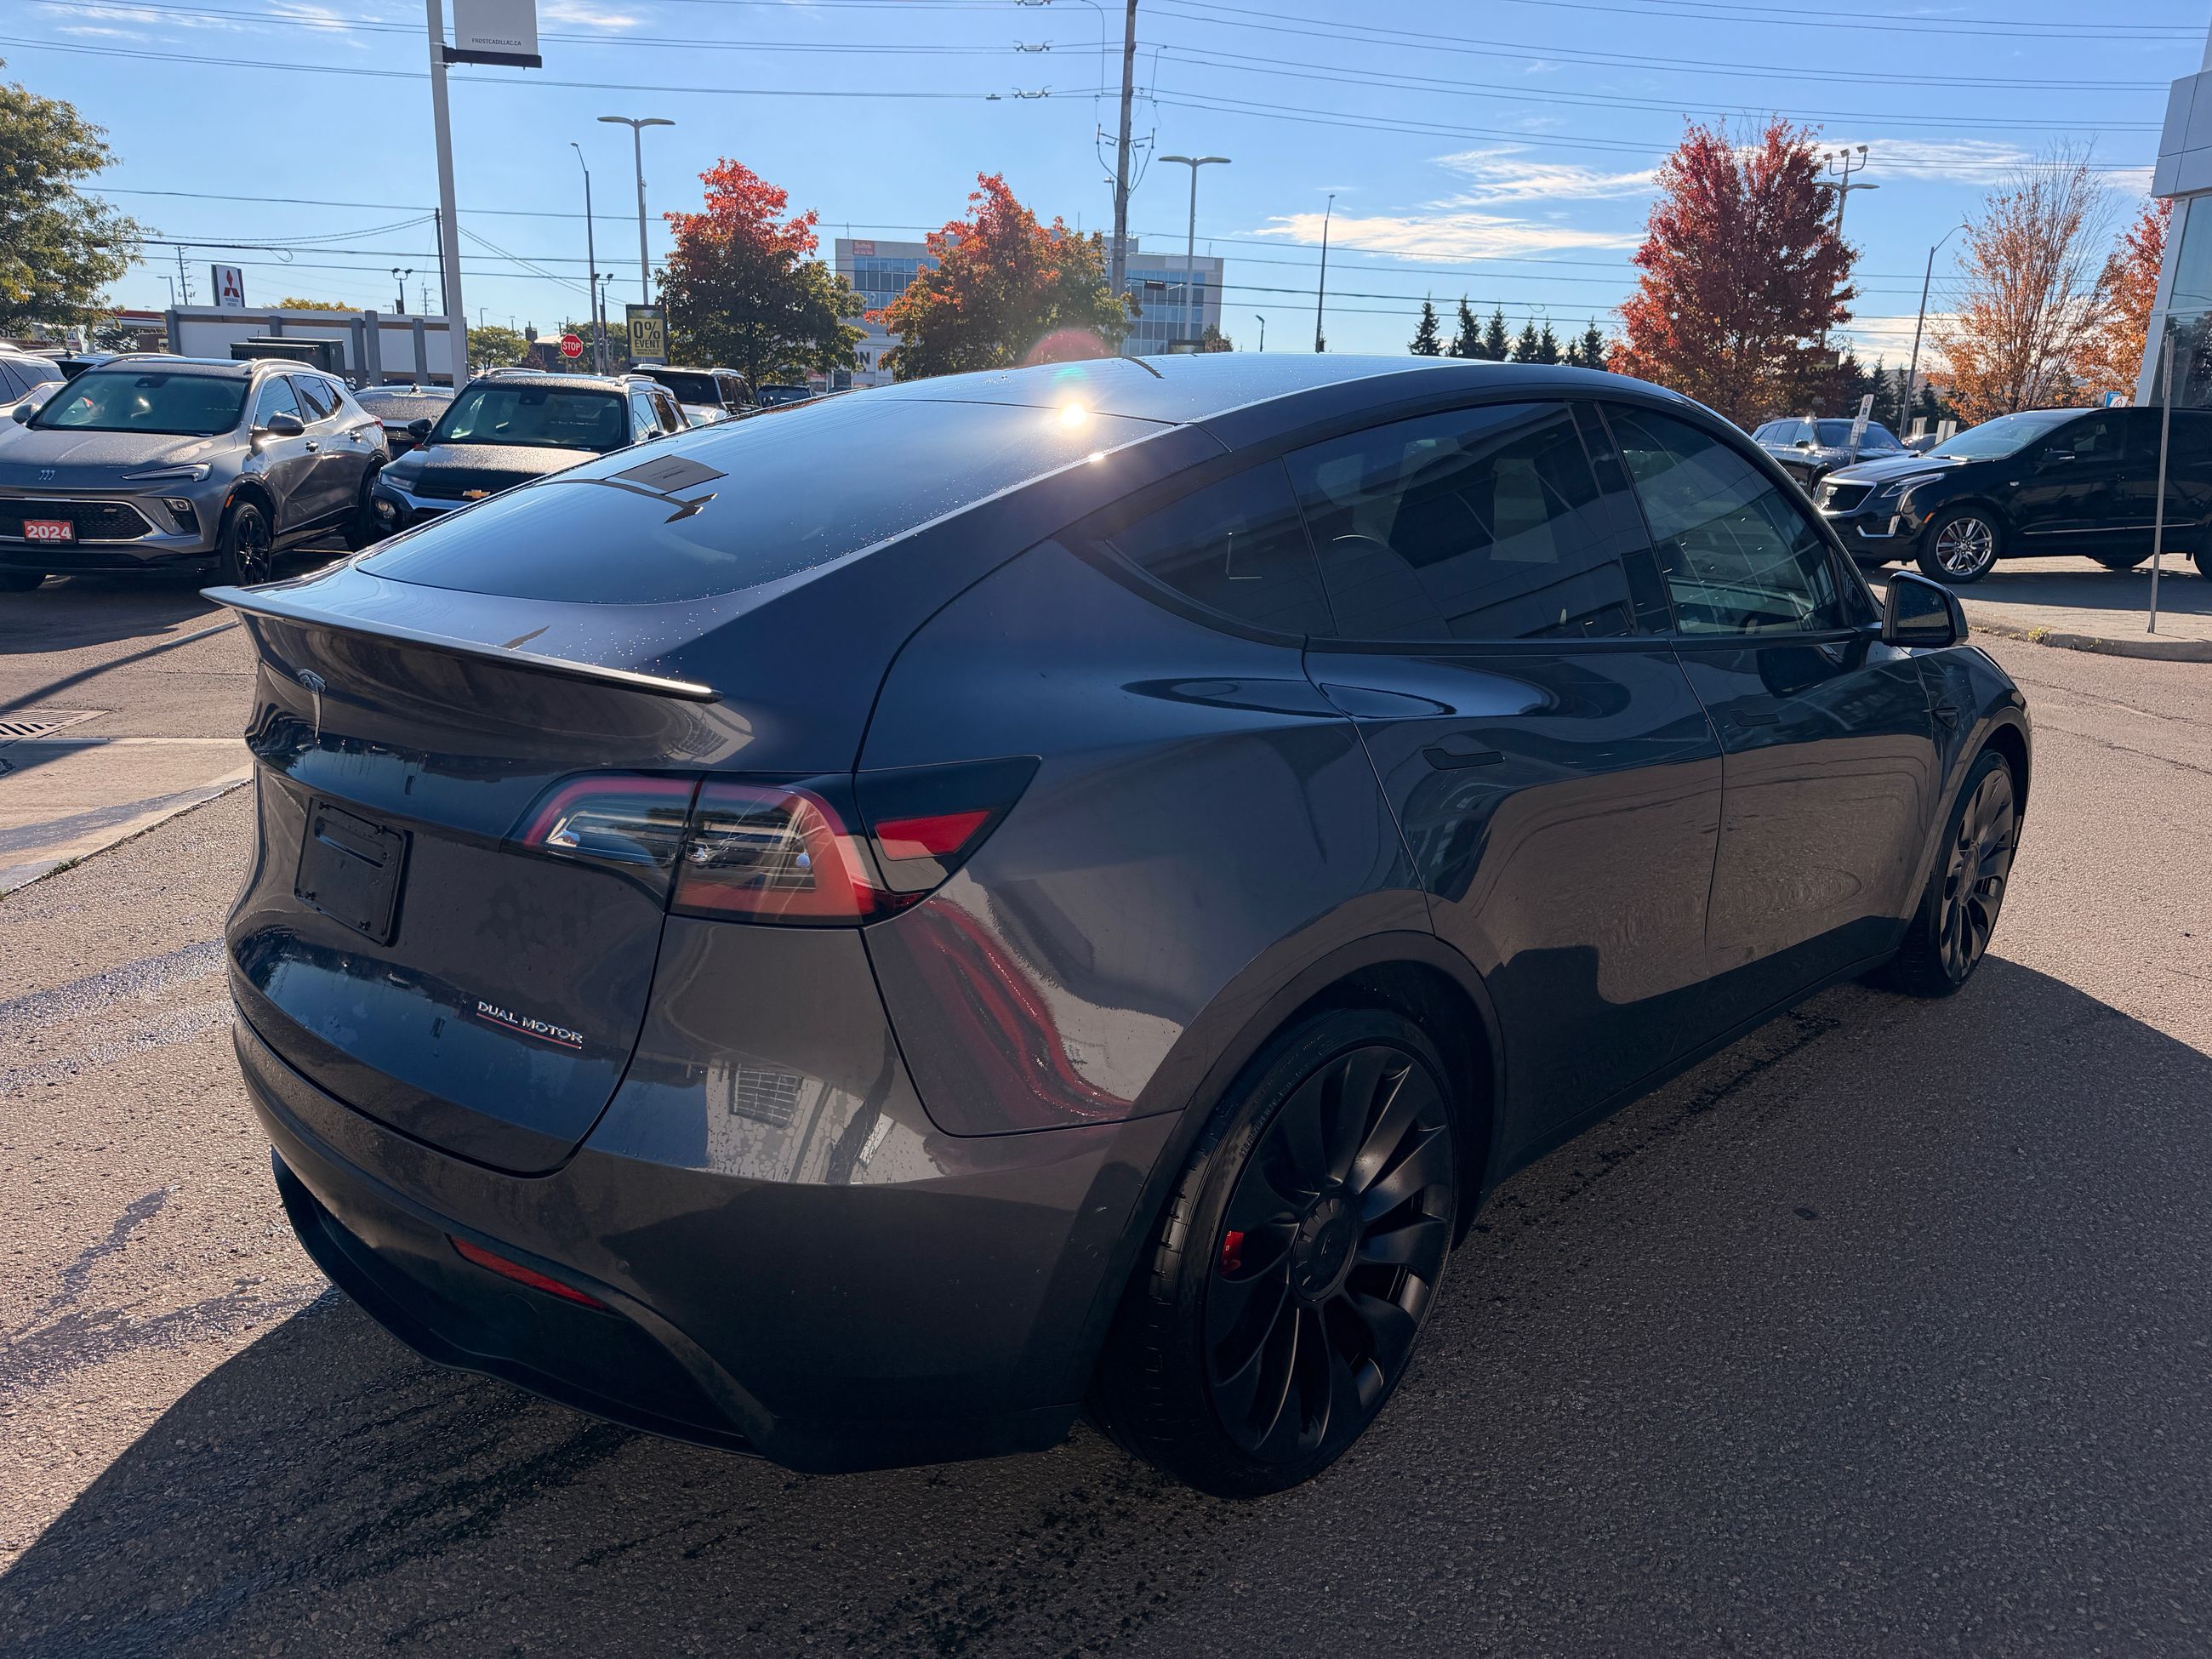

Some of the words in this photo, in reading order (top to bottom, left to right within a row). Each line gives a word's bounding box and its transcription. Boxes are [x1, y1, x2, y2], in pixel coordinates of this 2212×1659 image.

[471, 37, 522, 46] FROSTCADILLAC.CA
[633, 320, 661, 339] 0%
[562, 341, 580, 351] STOP
[635, 339, 660, 348] EVENT
[27, 525, 71, 539] 2024
[477, 1001, 518, 1023] DUAL
[522, 1017, 583, 1044] MOTOR
